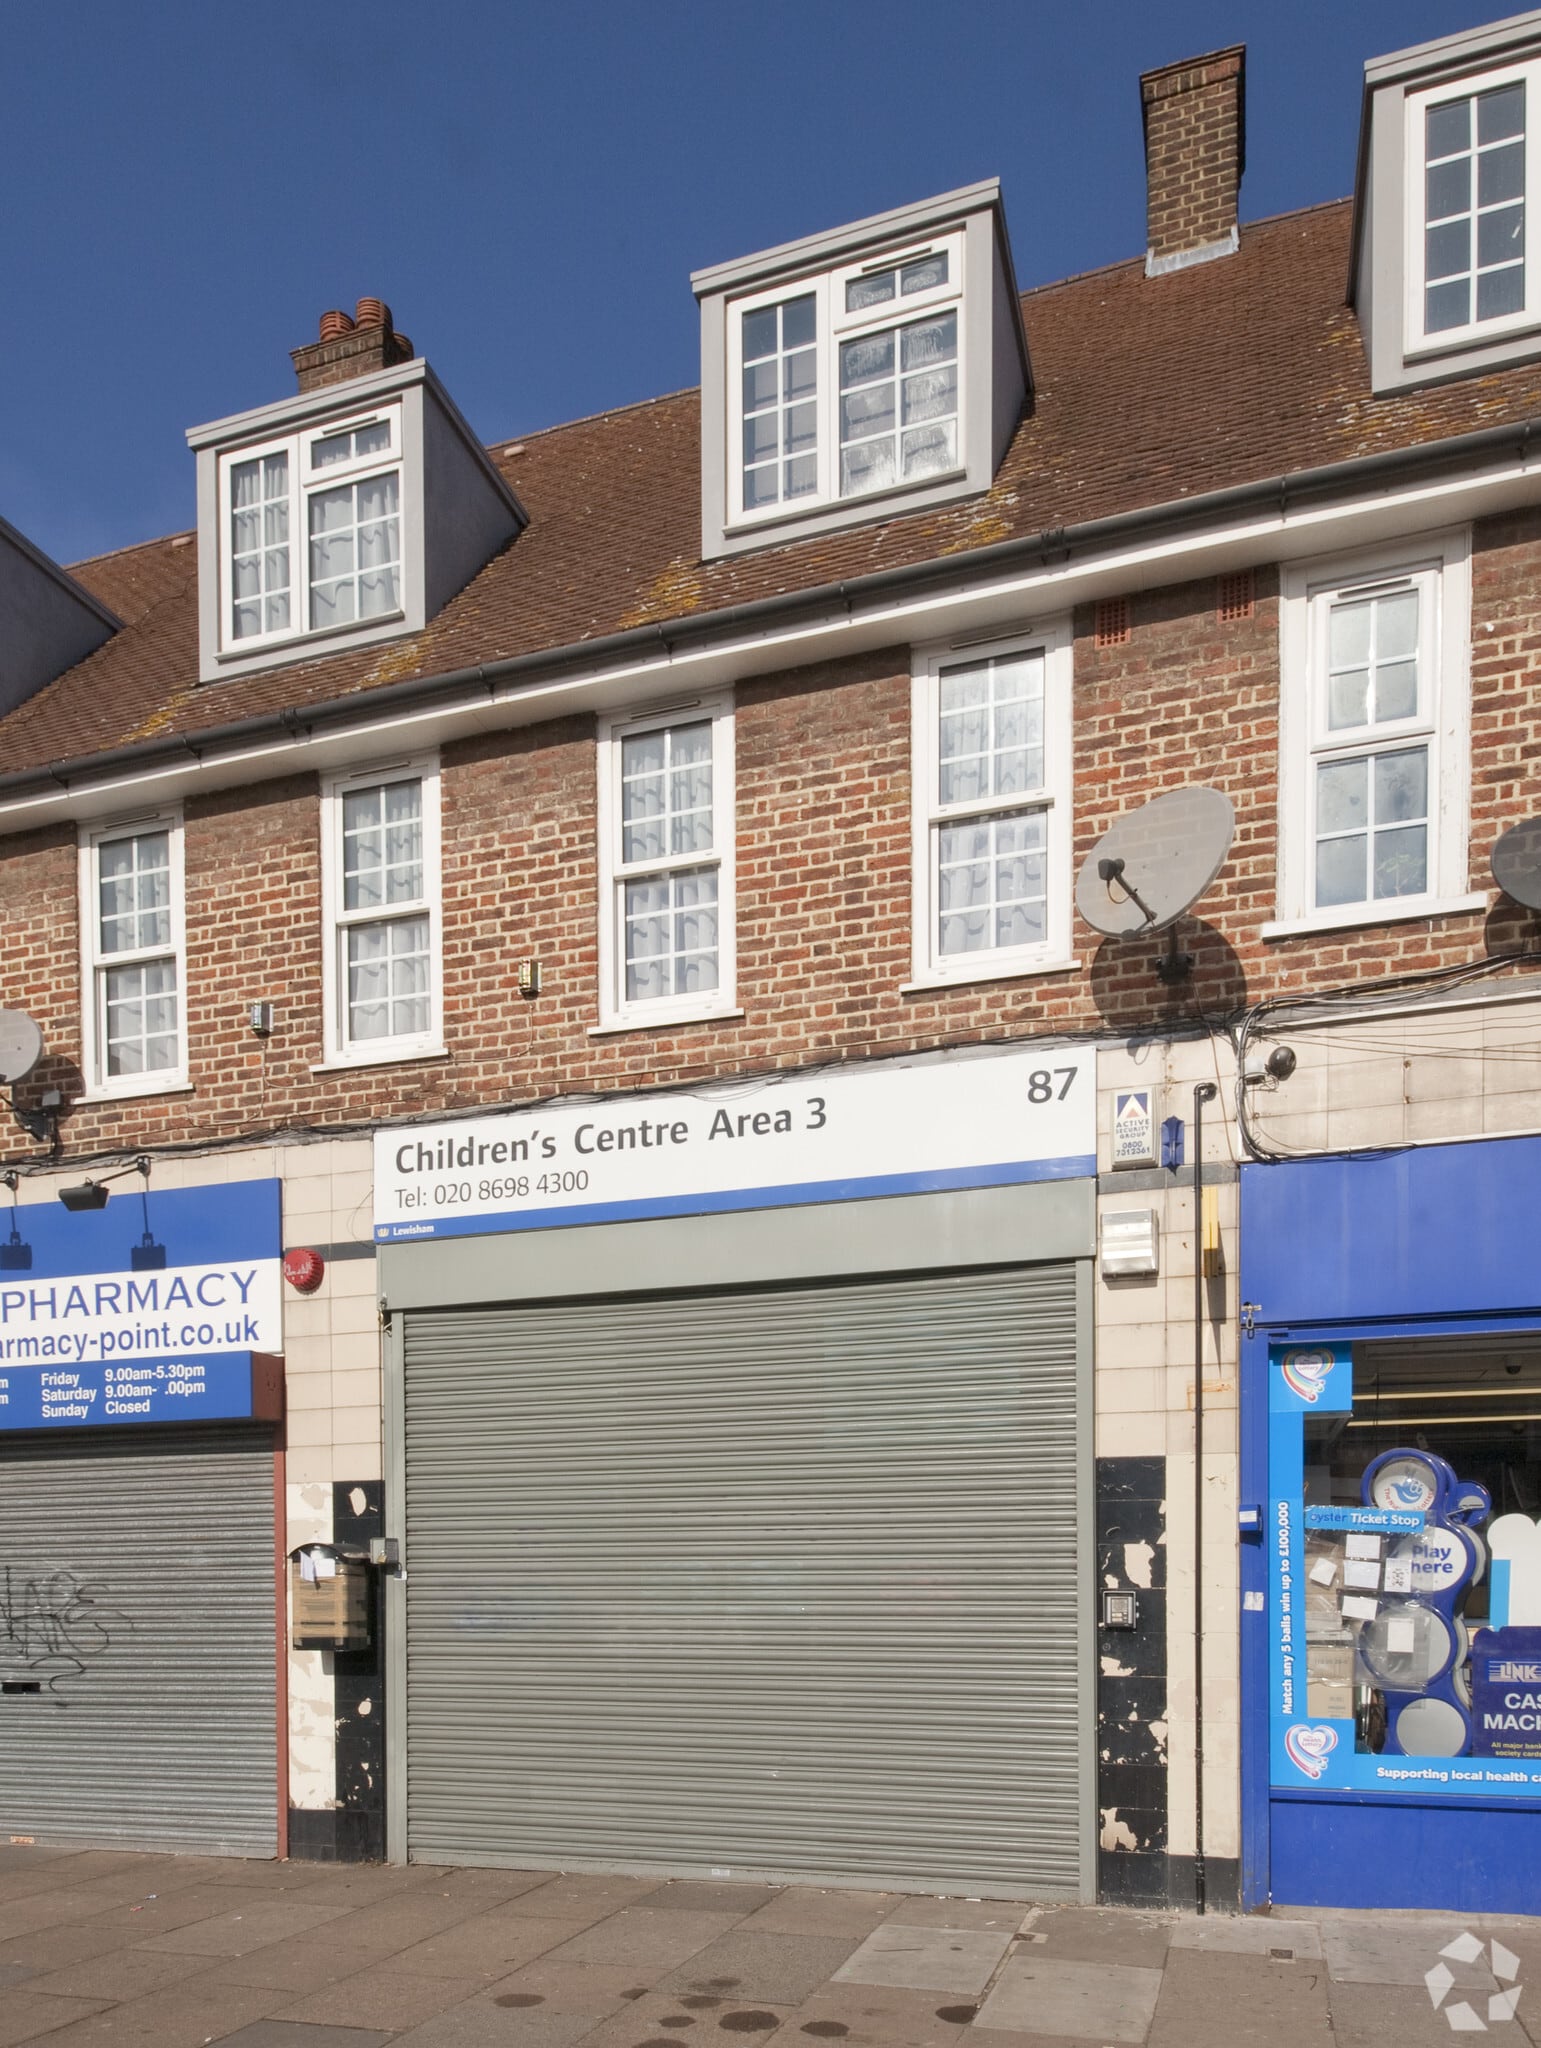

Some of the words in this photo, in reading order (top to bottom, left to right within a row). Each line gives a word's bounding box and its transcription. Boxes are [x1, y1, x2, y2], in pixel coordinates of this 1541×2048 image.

[1026, 1066, 1079, 1105] 87
[1116, 1118, 1150, 1128] ACTIVE
[1116, 1126, 1149, 1134] SECURITY
[395, 1130, 557, 1174] Children's
[573, 1117, 690, 1155] Centre
[707, 1108, 793, 1141] Area
[805, 1097, 828, 1130] 3
[1120, 1131, 1146, 1139] GROUP
[1122, 1140, 1143, 1149] 0800
[394, 1186, 427, 1209] Tel:
[434, 1182, 472, 1205] 020
[478, 1176, 530, 1200] 8698
[536, 1169, 589, 1195] 4300
[393, 1224, 435, 1236] Lewisham
[2, 1270, 258, 1323] PHARMACY
[41, 1372, 80, 1388] Friday
[104, 1364, 206, 1381] 9.00am-5.30pm
[41, 1386, 97, 1403] Saturday
[42, 1403, 89, 1419] Sunday
[105, 1399, 151, 1415] Closed
[1310, 1512, 1347, 1523] oyster
[1350, 1513, 1388, 1525] Ticket
[1391, 1514, 1421, 1527] Stop
[1278, 1501, 1291, 1556] £100,000
[1411, 1545, 1453, 1561] Play
[1280, 1559, 1290, 1572] to
[1411, 1561, 1453, 1574] here
[1281, 1574, 1292, 1590] up
[1280, 1592, 1291, 1613] win
[1280, 1614, 1291, 1643] balls
[1281, 1643, 1292, 1653] 5
[1282, 1655, 1295, 1677] any
[1500, 1661, 1540, 1682] LINK
[1281, 1678, 1293, 1715] Match
[1376, 1767, 1449, 1782] Supporting
[1451, 1769, 1482, 1781] local
[1486, 1771, 1528, 1783] health
